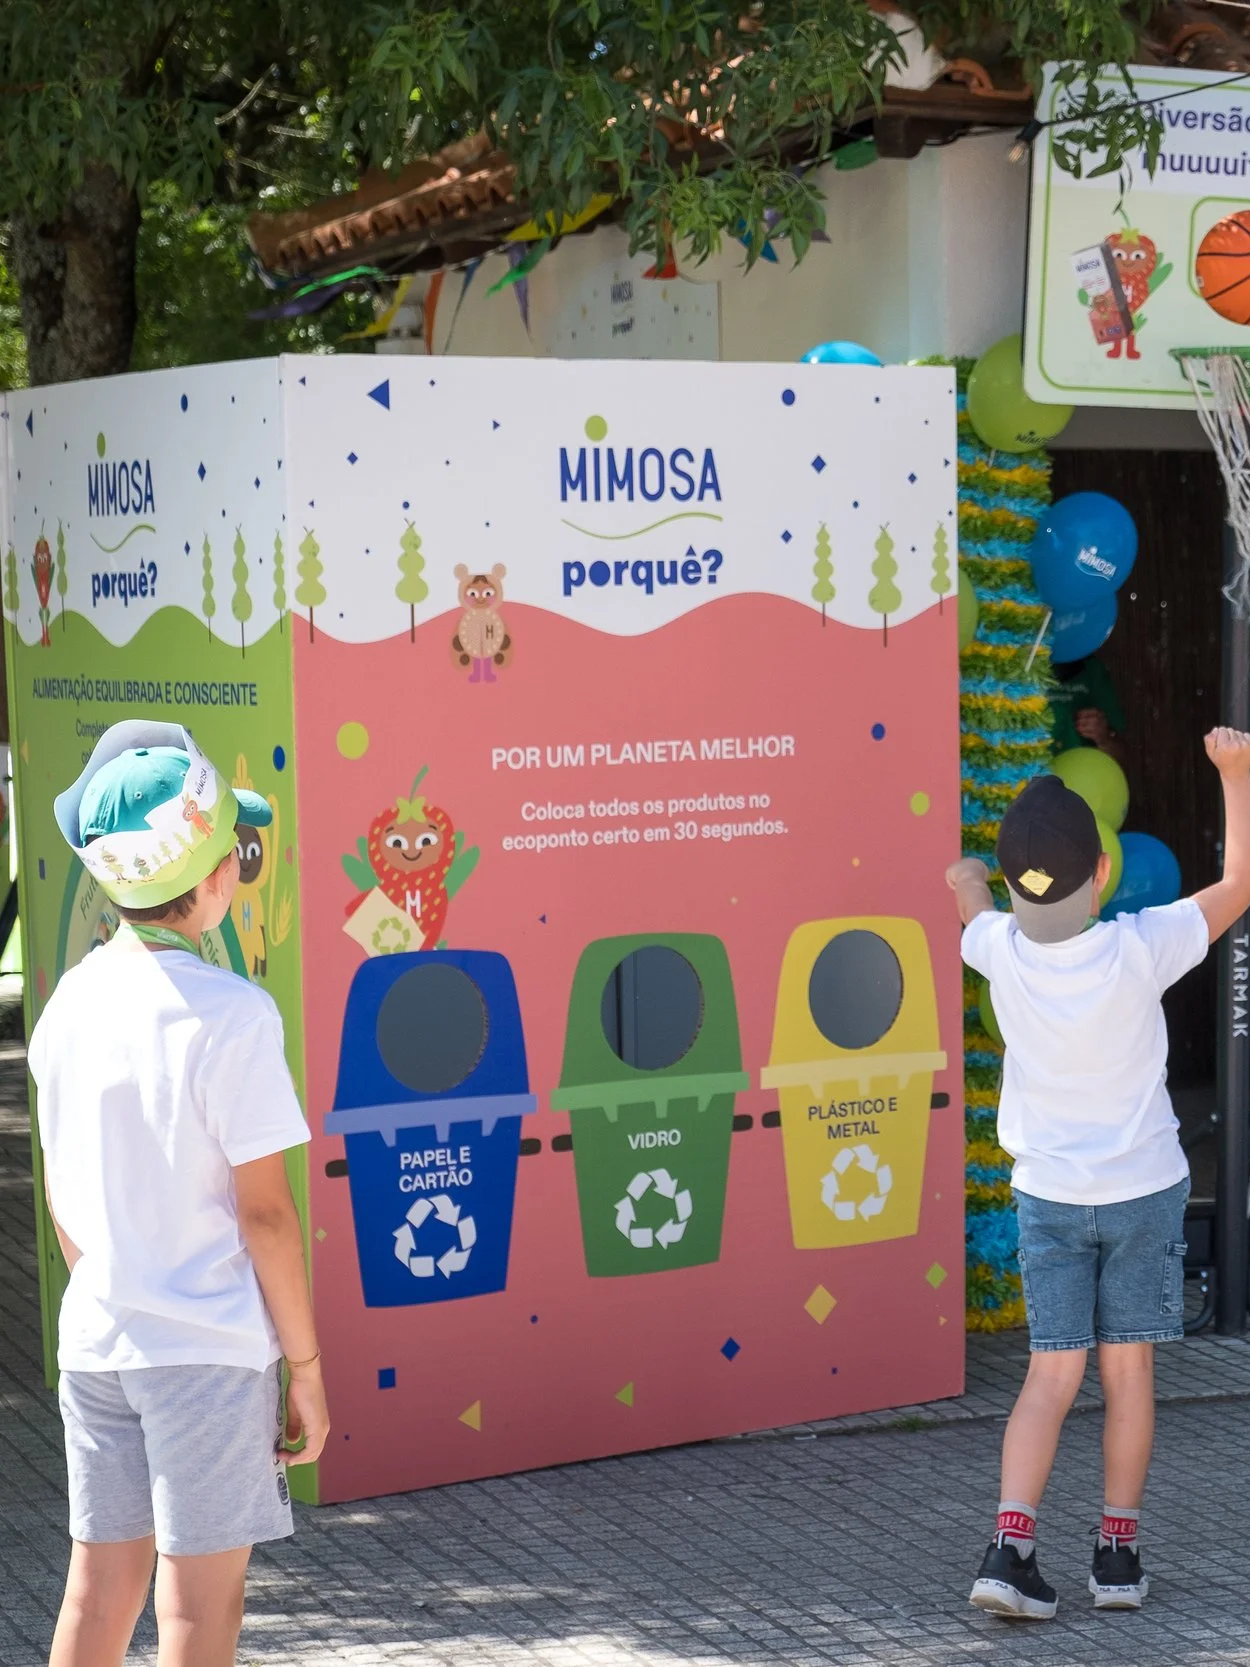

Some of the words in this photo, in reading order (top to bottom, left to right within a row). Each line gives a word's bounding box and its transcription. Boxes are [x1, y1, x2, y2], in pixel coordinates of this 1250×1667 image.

[88, 459, 156, 517] MIMOSA
[559, 447, 722, 502] MIMOSA
[91, 558, 158, 608] porquê?
[563, 545, 723, 596] porquê?
[33, 674, 94, 705] ALIMENTAÇÃO
[96, 680, 163, 703] EQUILIBRADA
[165, 682, 172, 704] E
[174, 682, 257, 706] CONSCIENTE
[492, 746, 541, 770] POR
[546, 744, 585, 767] UM
[590, 740, 696, 765] PLANETA
[700, 735, 795, 760] MELHOR
[521, 801, 585, 822] Coloca
[589, 799, 639, 818] todos
[643, 800, 664, 816] os
[668, 795, 744, 818] produtos
[749, 795, 770, 809] no
[502, 830, 589, 853] ecoponto
[593, 827, 639, 846] certo
[643, 827, 670, 842] em
[674, 822, 697, 841] 30
[701, 818, 788, 842] segundos.
[1232, 934, 1249, 1038] TARMAK
[808, 1098, 884, 1122] PLÁSTICO
[888, 1098, 897, 1113] E
[627, 1129, 681, 1150] VIDRO
[827, 1119, 879, 1139] METAL
[400, 1148, 456, 1170] PAPEL
[458, 1146, 471, 1164] E
[399, 1166, 472, 1191] CARTÃO
